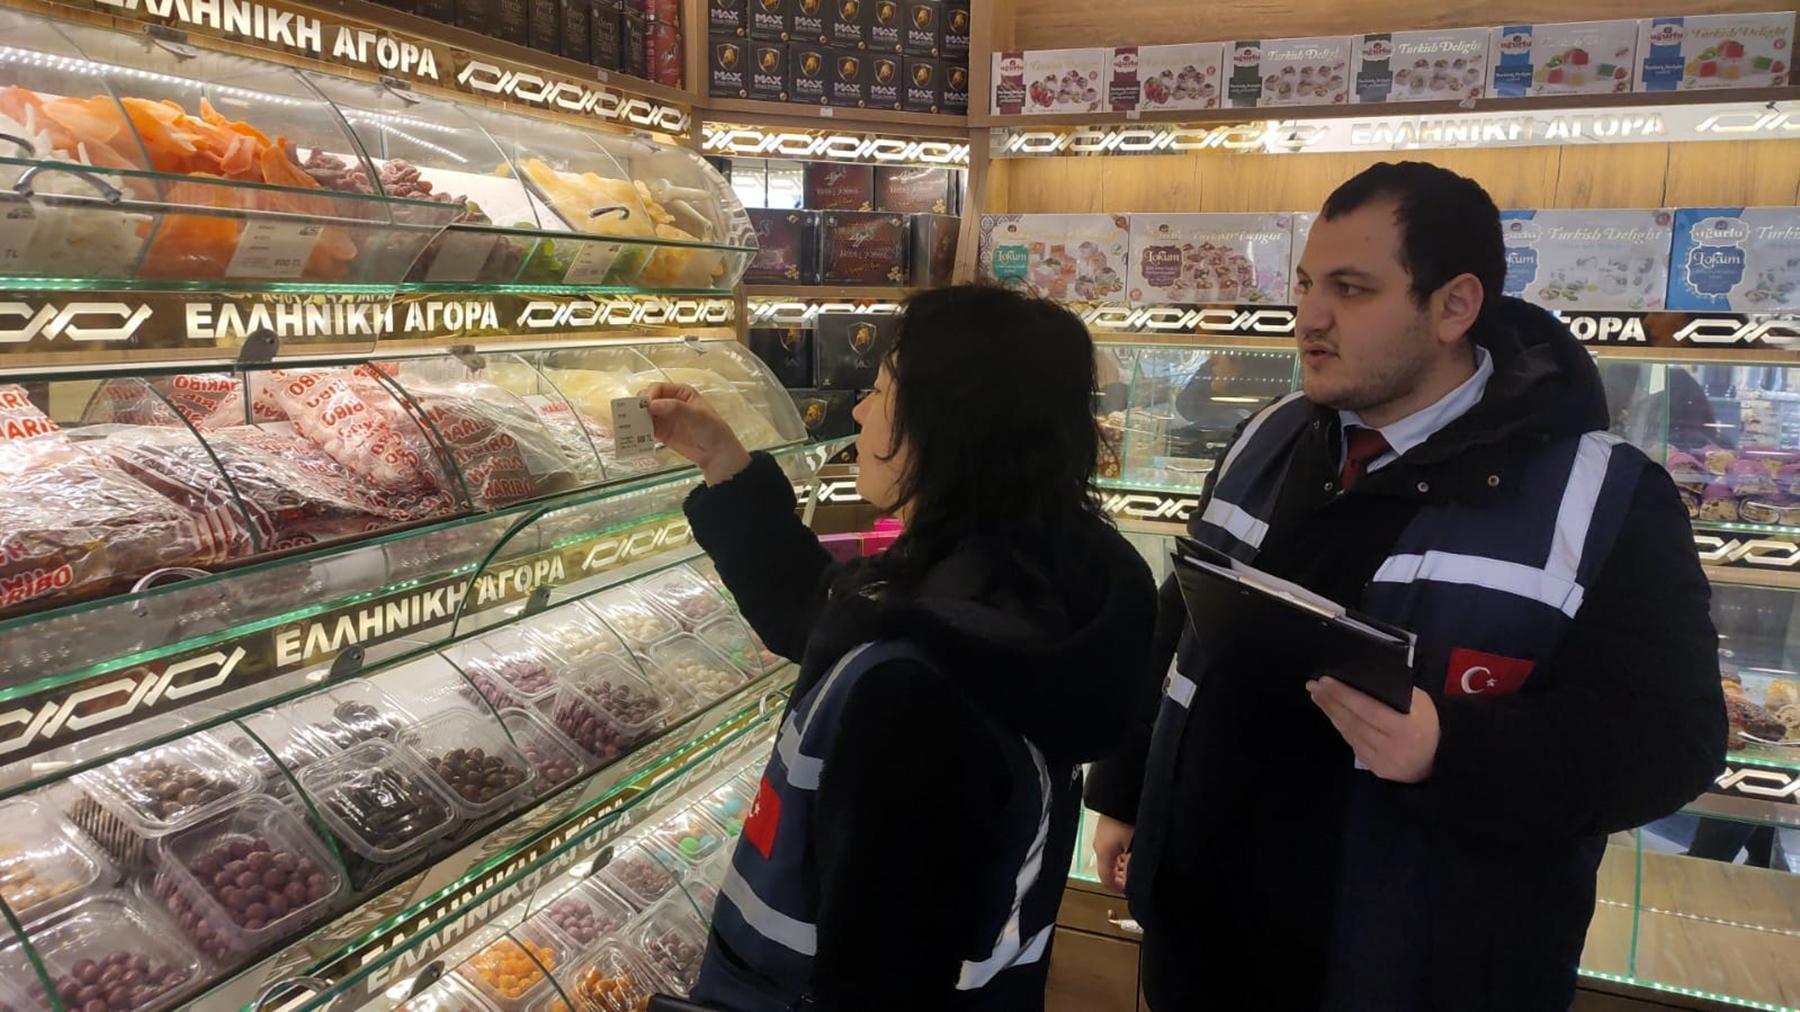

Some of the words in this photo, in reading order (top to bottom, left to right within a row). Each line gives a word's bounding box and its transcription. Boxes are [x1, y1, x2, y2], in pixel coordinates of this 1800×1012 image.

[711, 8, 738, 20] MAX
[755, 13, 783, 25] MAX
[794, 16, 822, 28] MAX
[834, 22, 861, 34] MAX
[872, 26, 898, 38] MAX
[908, 30, 934, 42] MAX
[97, 0, 322, 53] ΛΗΝΙΚΗ
[333, 26, 439, 80] ΑΓΟΡΑ
[713, 71, 742, 82] MAX
[754, 74, 782, 86] MAX
[796, 78, 823, 89] MAX
[834, 82, 861, 93] MAX
[871, 85, 896, 96] MAX
[908, 88, 934, 99] MAX
[1350, 115, 1534, 146] ΕΛΛΗΝΙΚΗ
[1545, 111, 1668, 139] ΑΓΟΡΑ
[1549, 226, 1601, 241] Turkish
[1603, 226, 1663, 244] Delight
[1693, 251, 1741, 270] Lokum
[186, 301, 394, 338] ΕΛΛΗΝΙΚΗ
[404, 301, 499, 332] ΑΓΟΡΑ
[276, 582, 468, 668] ΕΛΛΗΝΙΚΗ
[477, 554, 565, 605] ΑΓΟΡΑ
